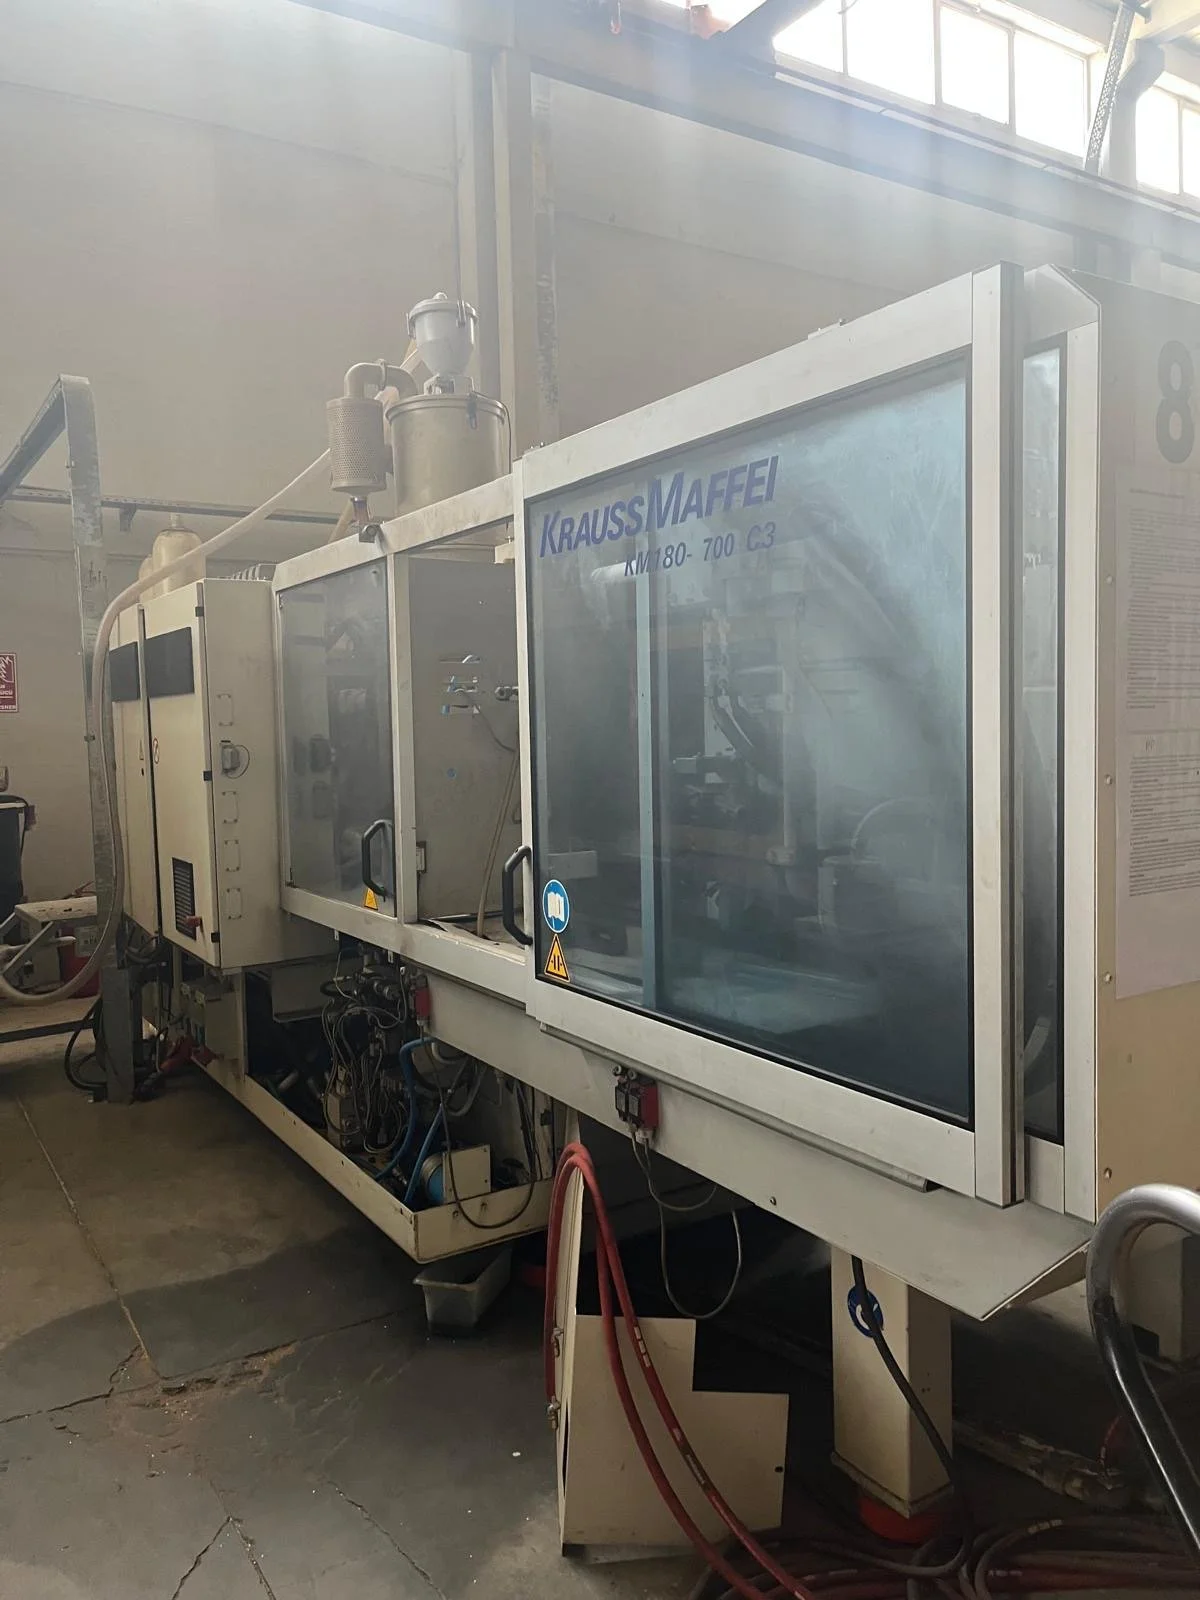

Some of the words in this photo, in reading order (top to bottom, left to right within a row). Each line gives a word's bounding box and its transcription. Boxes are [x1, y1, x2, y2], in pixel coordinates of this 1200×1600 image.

[1156, 340, 1195, 464] 8
[703, 533, 735, 562] 700
[747, 521, 776, 552] C3
